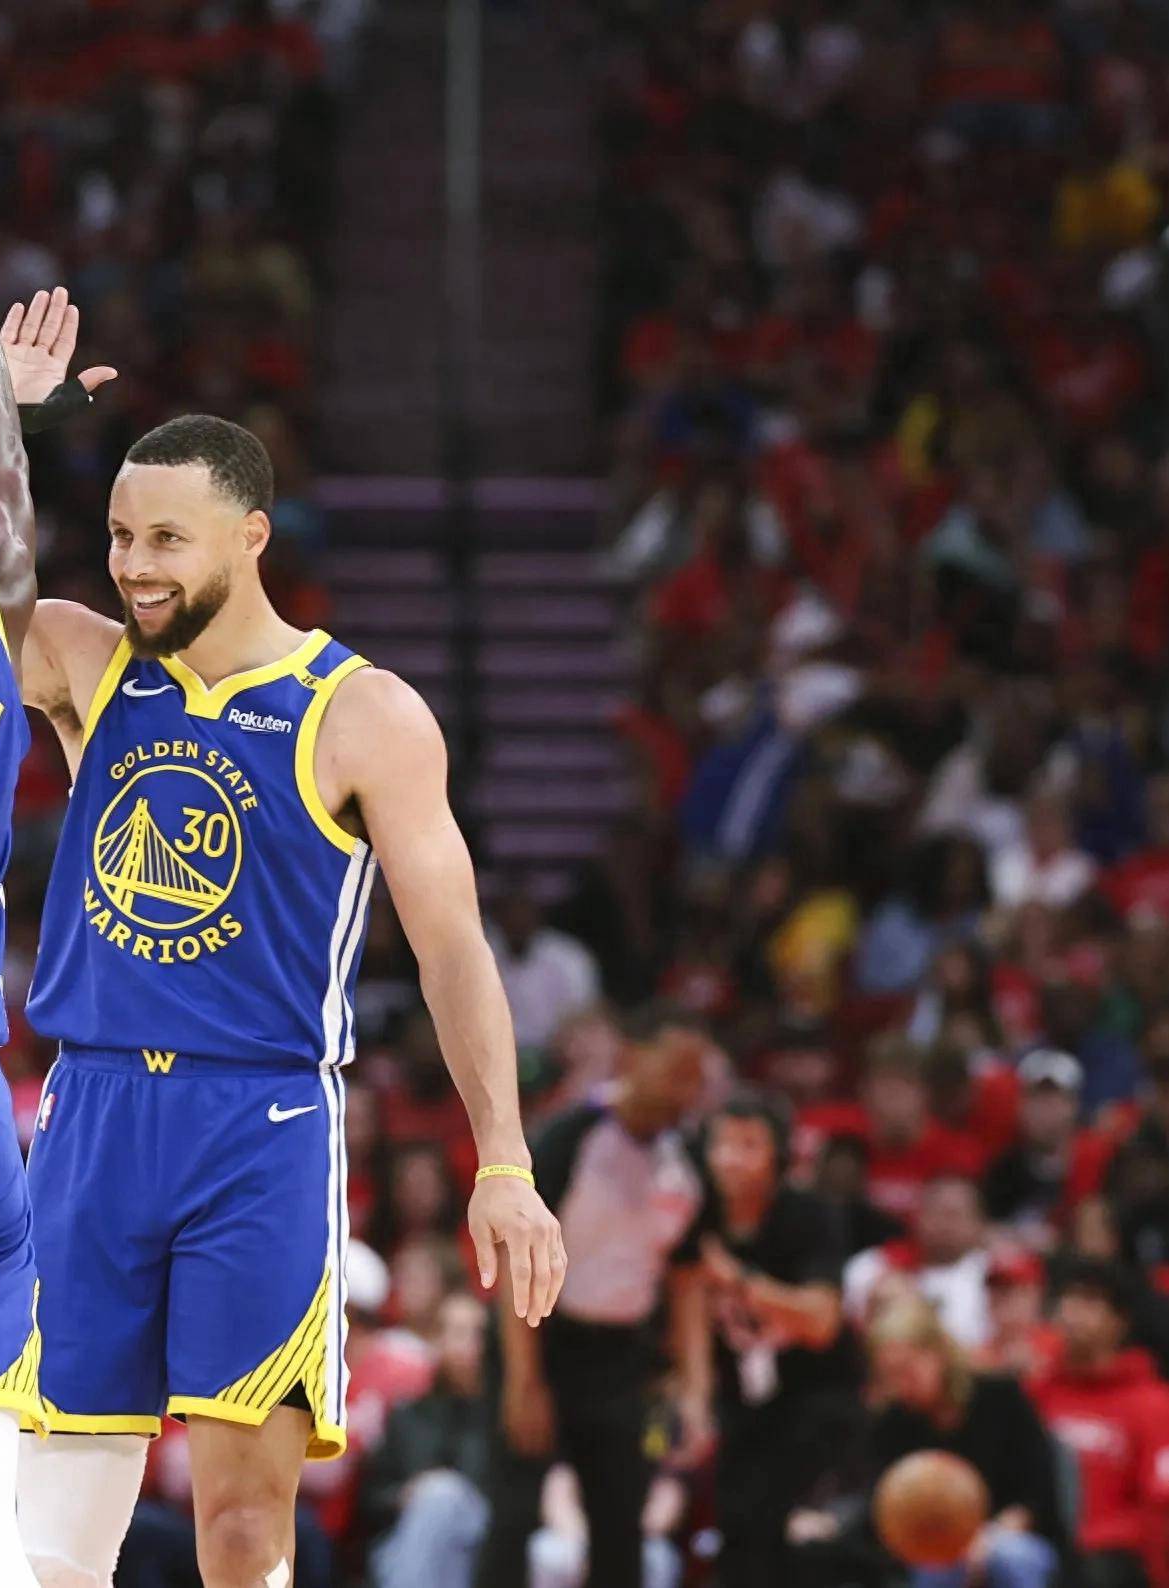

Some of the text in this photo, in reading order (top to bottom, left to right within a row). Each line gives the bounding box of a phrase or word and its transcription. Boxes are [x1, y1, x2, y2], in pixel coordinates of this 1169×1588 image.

[227, 708, 292, 733] Rakuten
[110, 740, 258, 811] GOLDEN STATE
[174, 807, 230, 858] 30
[84, 877, 243, 964] WARRIORS
[141, 1049, 176, 1073] W
